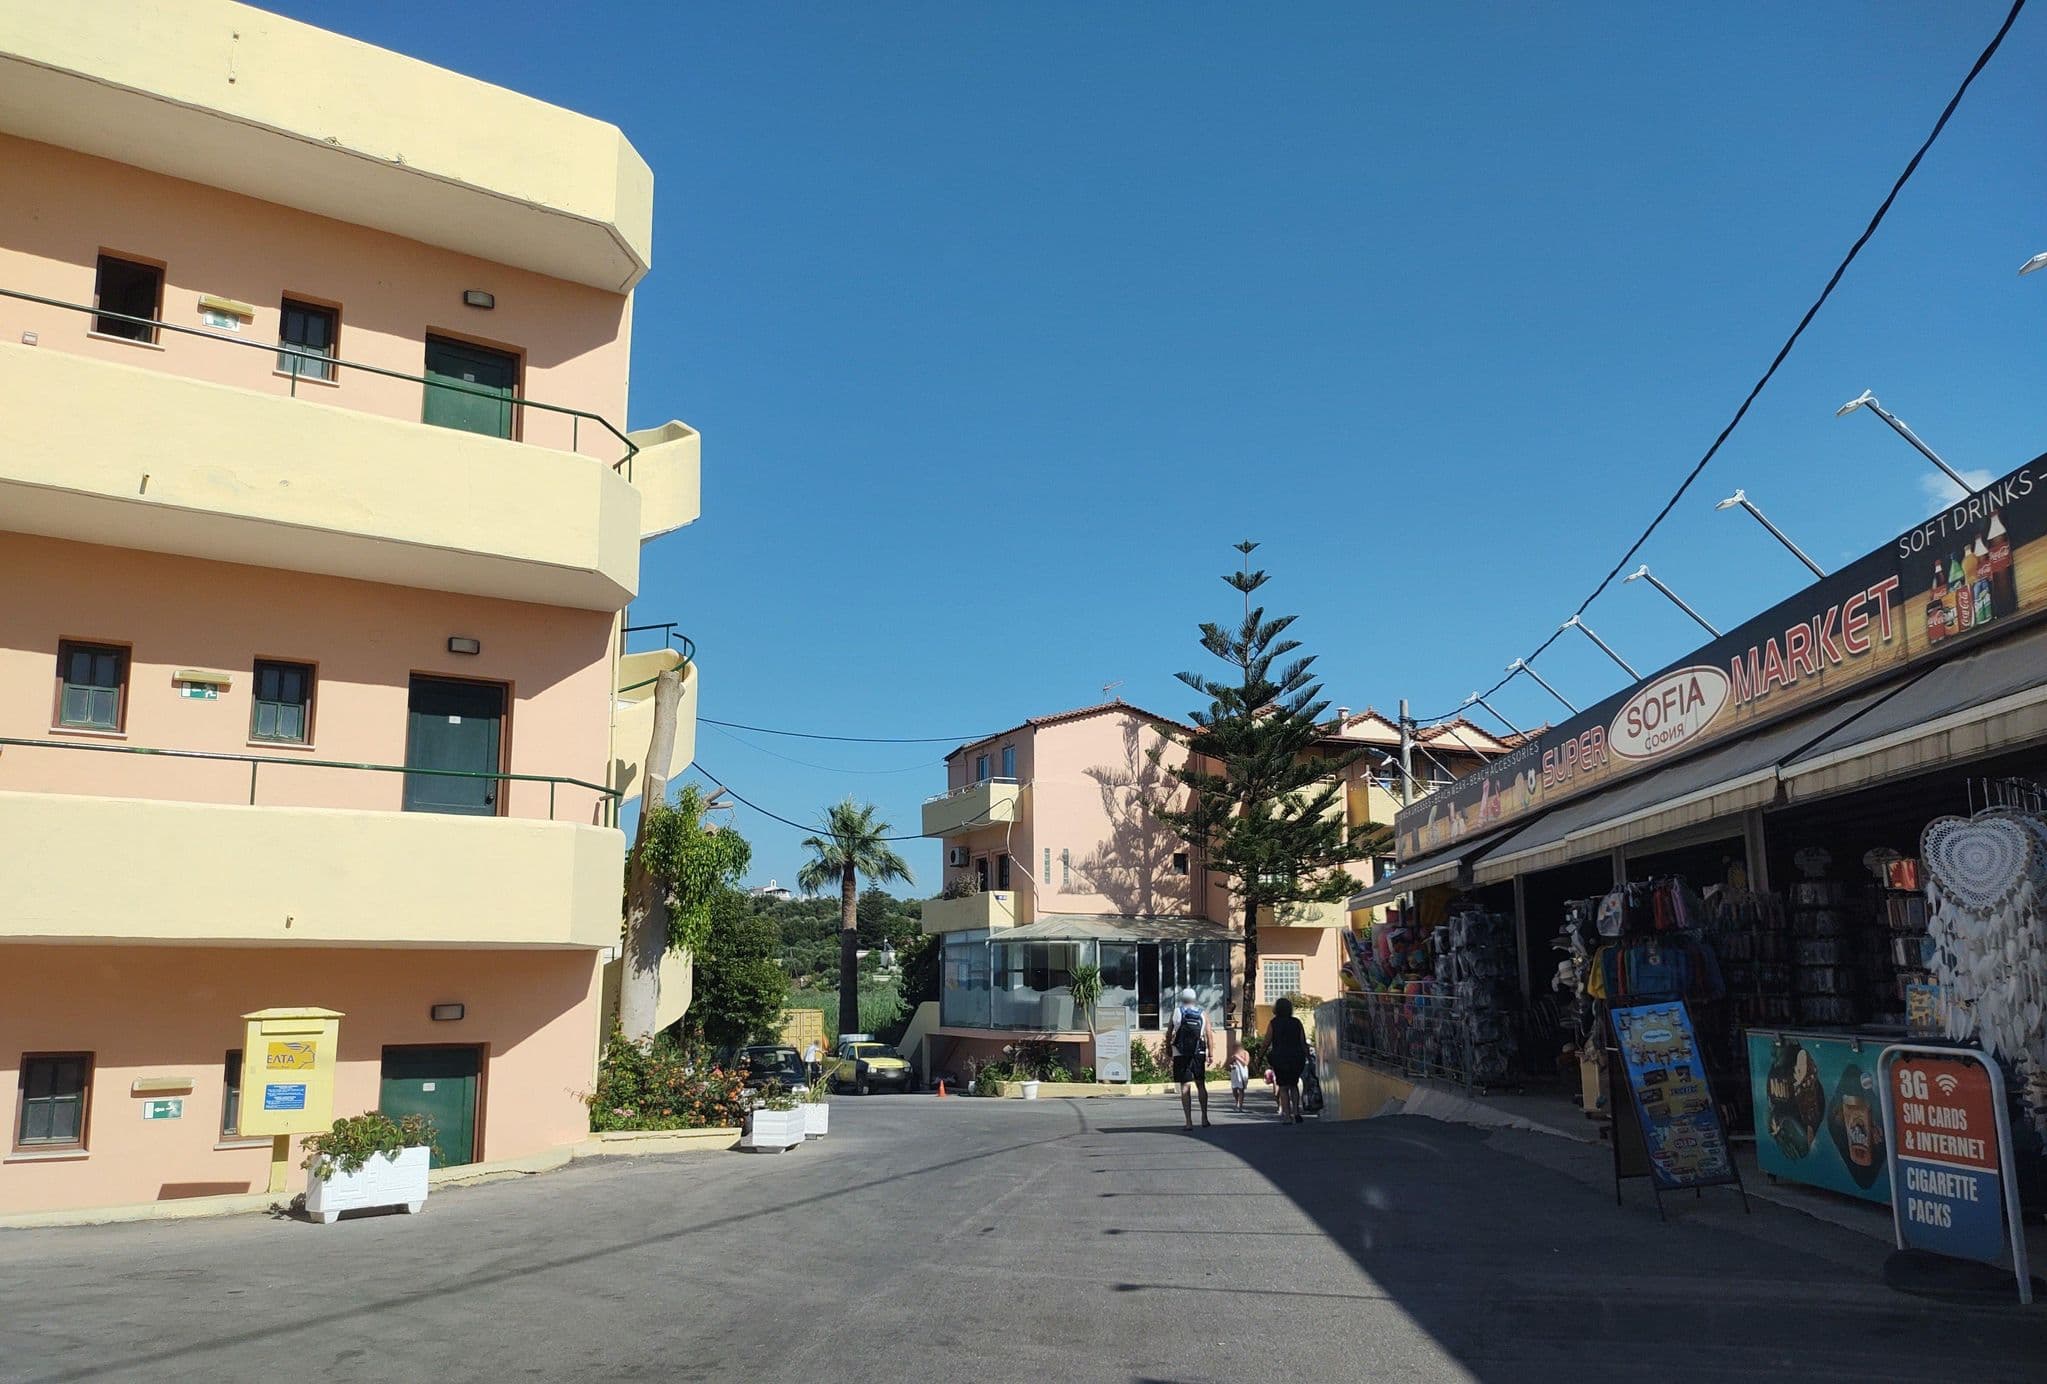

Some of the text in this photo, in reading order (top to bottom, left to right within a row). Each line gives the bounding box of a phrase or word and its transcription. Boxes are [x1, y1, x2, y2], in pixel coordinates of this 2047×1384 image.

[1899, 514, 1948, 559] SOFT
[1953, 469, 2033, 531] DRINKS
[1731, 574, 1899, 706] MARKET
[1626, 676, 1706, 739] SOFIA
[1644, 723, 1685, 751] СОФИЯ
[1490, 741, 1540, 776] ACCESSORIES
[1542, 725, 1607, 789] SUPER
[266, 1054, 295, 1064] ΕΛΤΑ
[1899, 1069, 1929, 1100] 3G
[1902, 1102, 1968, 1131] SIM CARDS
[1905, 1130, 1985, 1160] & INTERNET
[1906, 1166, 1979, 1202] CIGARETTE
[1908, 1197, 1952, 1229] PACKS
